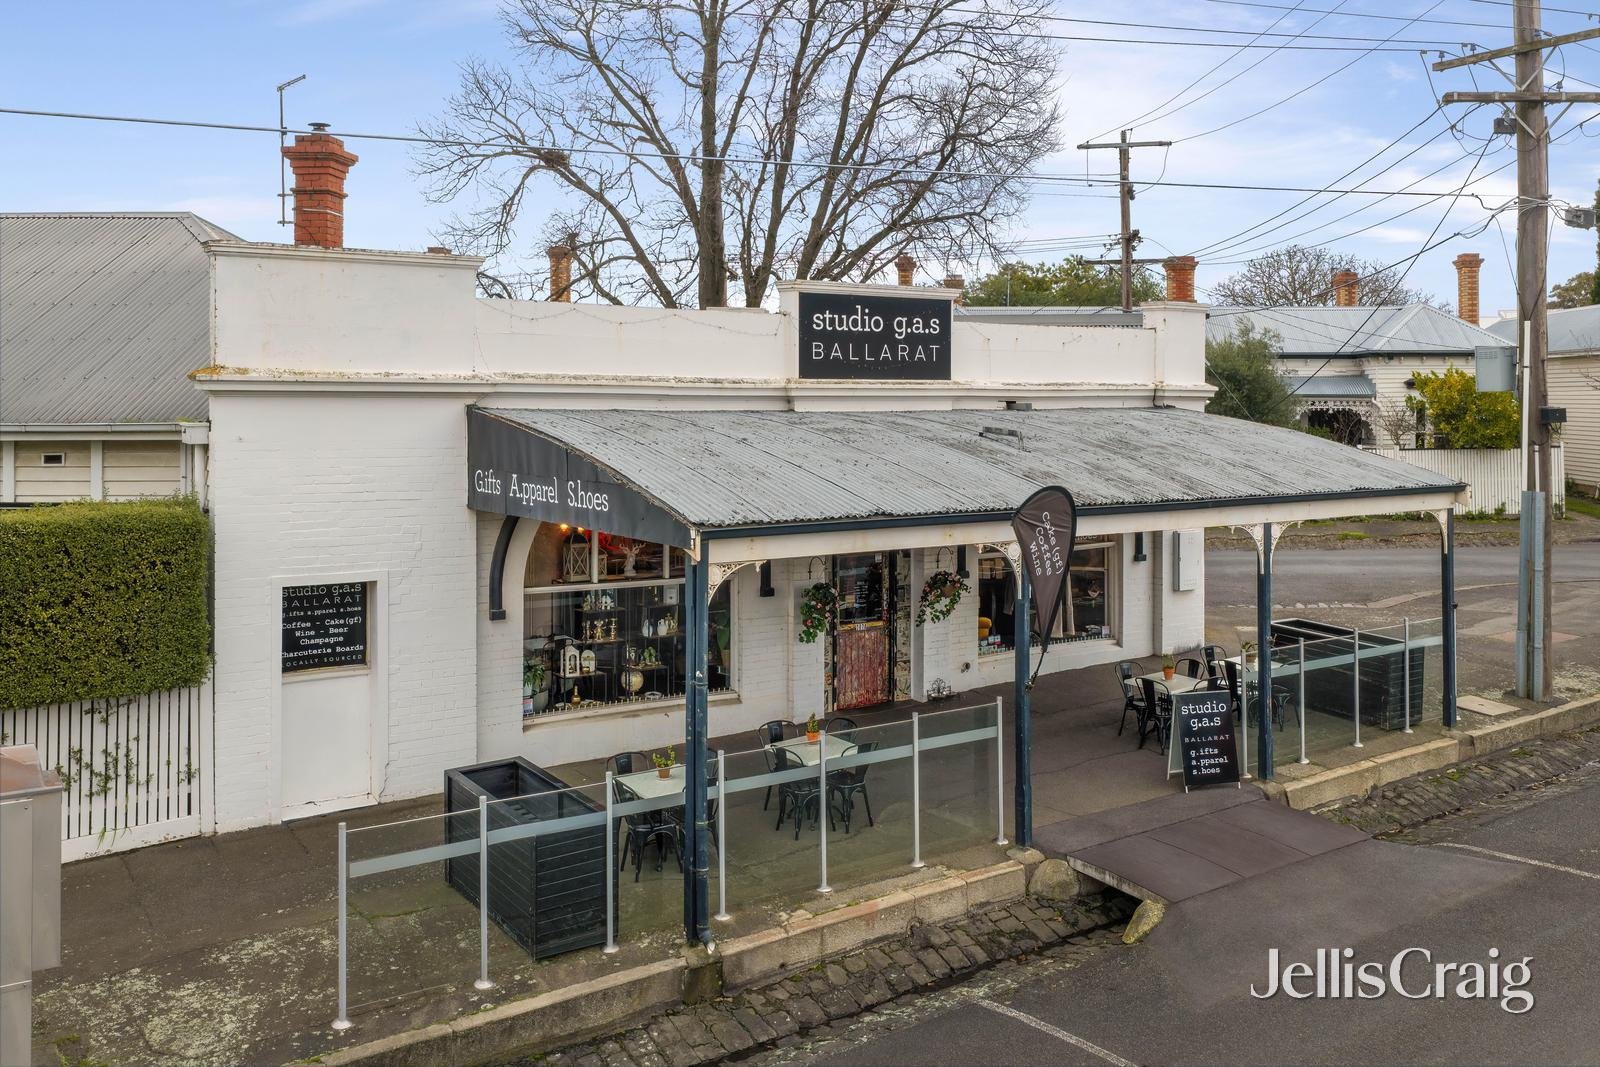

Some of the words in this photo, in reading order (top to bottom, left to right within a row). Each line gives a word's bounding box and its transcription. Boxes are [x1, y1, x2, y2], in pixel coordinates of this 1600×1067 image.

[812, 305, 884, 332] studio
[893, 316, 940, 339] g.a.s
[812, 341, 940, 362] BALLARAT
[474, 469, 501, 495] G.ifts
[509, 473, 559, 506] A.pparel
[567, 479, 609, 512] S.hoes
[1035, 527, 1052, 576] Coffee
[1029, 541, 1042, 576] Wine
[282, 585, 327, 597] studio
[331, 583, 362, 596] g.a.s
[295, 629, 315, 637] Wine
[300, 636, 344, 645] Champagne
[336, 644, 364, 653] Boards
[282, 658, 318, 668] OCALLY
[1181, 700, 1227, 715] studio
[1190, 716, 1221, 730] g.a.s
[1184, 734, 1230, 743] BALLARAT
[1190, 747, 1219, 757] g.ifts
[1191, 755, 1229, 766] a.pparel
[1192, 767, 1221, 775] s.hoes
